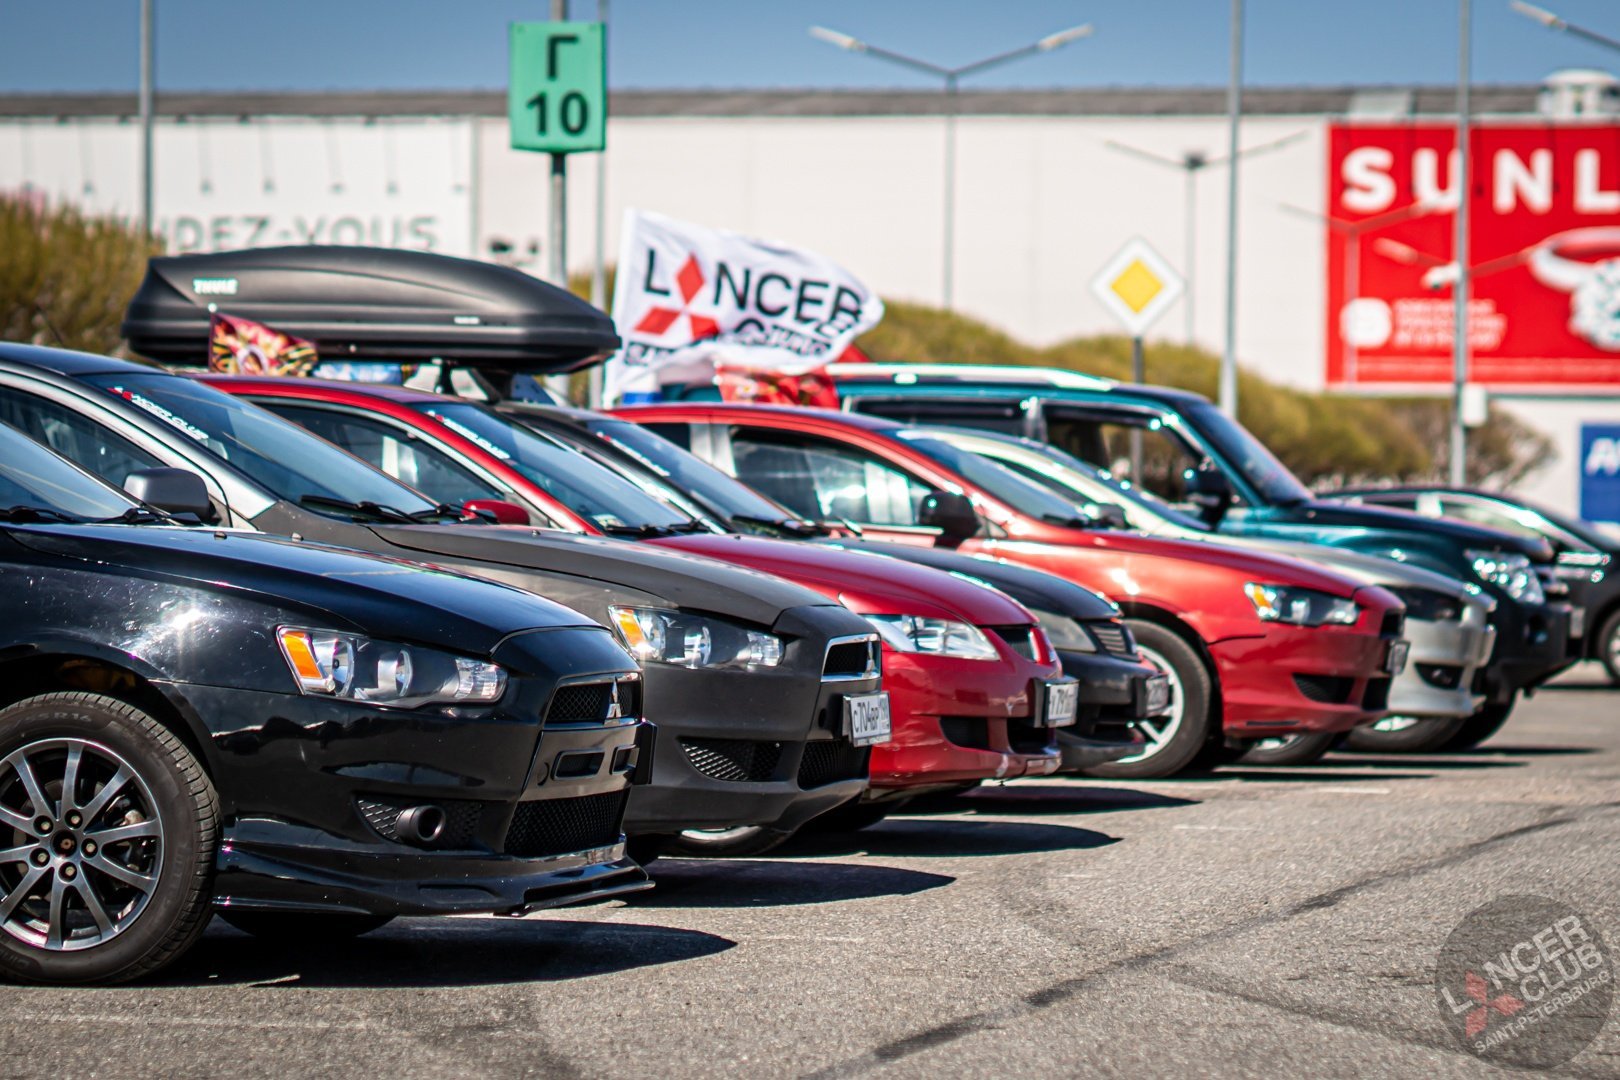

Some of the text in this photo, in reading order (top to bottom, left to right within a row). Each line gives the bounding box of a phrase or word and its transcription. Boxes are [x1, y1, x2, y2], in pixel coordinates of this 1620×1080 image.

[525, 90, 590, 137] 10
[1341, 147, 1620, 215] SUNL
[643, 248, 863, 324] LNCER
